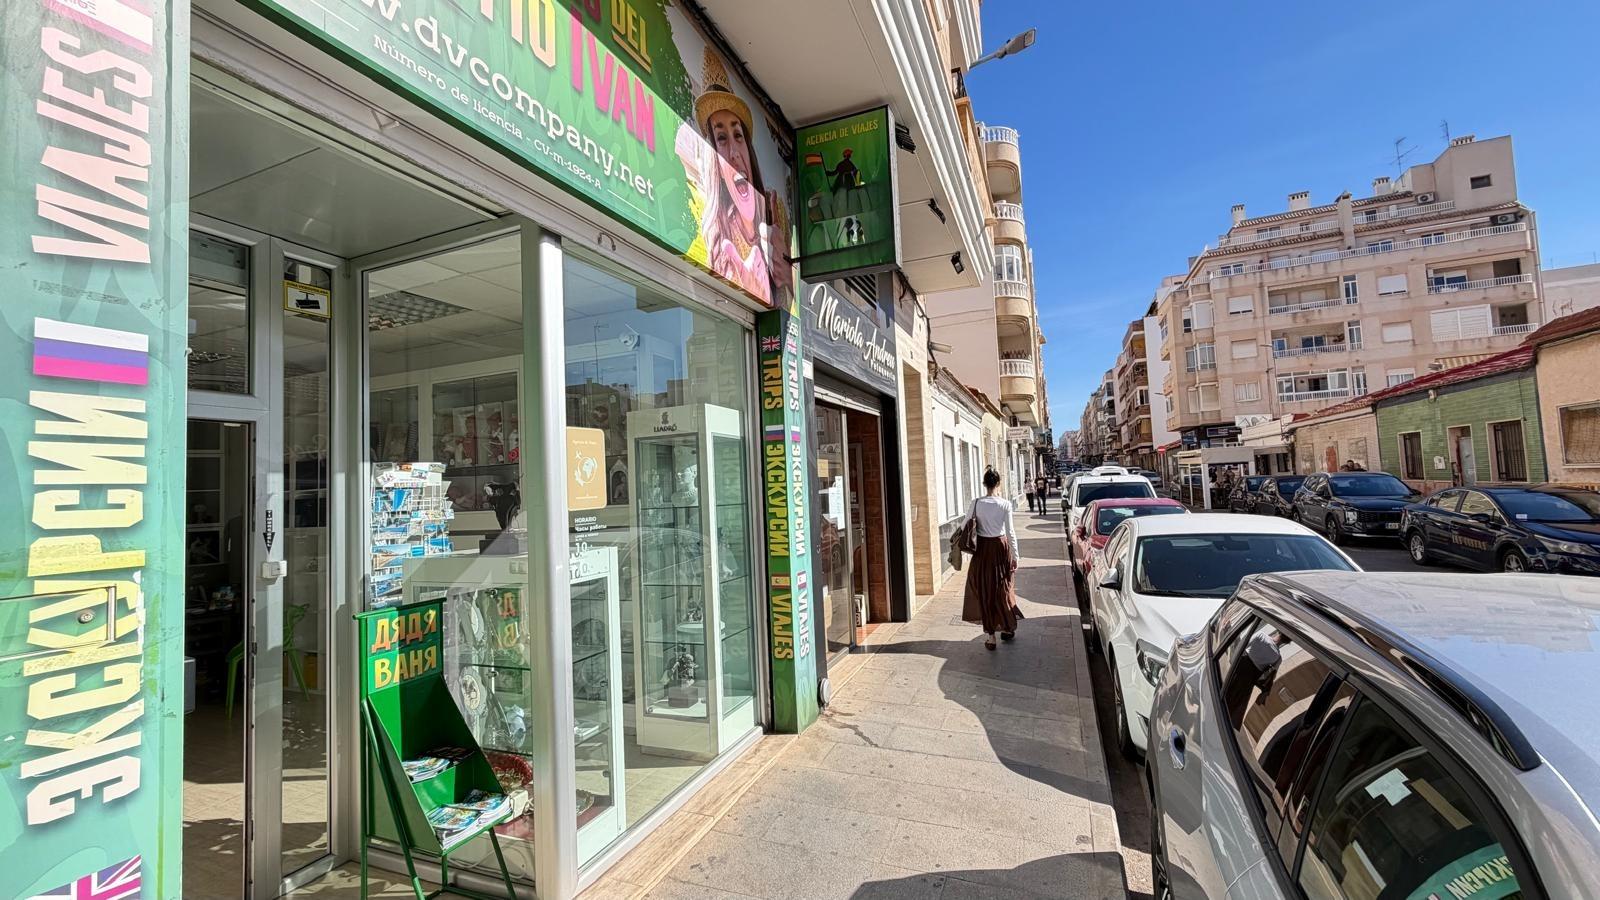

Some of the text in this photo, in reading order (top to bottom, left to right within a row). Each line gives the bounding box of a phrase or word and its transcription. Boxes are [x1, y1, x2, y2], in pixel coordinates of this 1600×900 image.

[611, 0, 651, 64] DEL
[374, 34, 447, 90] Número
[451, 86, 469, 105] de
[473, 98, 522, 140] licencia
[481, 0, 656, 153] IO IVAN
[32, 27, 152, 263] VIAJES
[806, 119, 878, 146] AGENCIA DE VIAJES
[811, 283, 865, 348] Mariola
[763, 355, 783, 410] TRIPS
[787, 359, 800, 411] TRIPS
[575, 516, 597, 524] HORARIO
[766, 443, 790, 557] ЭКСКУРСИИ
[791, 443, 806, 557] ЭКСКУРСИИ
[21, 390, 148, 826] ЭКСКУРСИИ
[371, 608, 437, 653] ДЯДЯ
[771, 593, 794, 660] VIAJES
[797, 591, 810, 659] VIAJES
[374, 645, 437, 689] ВАНЯ
